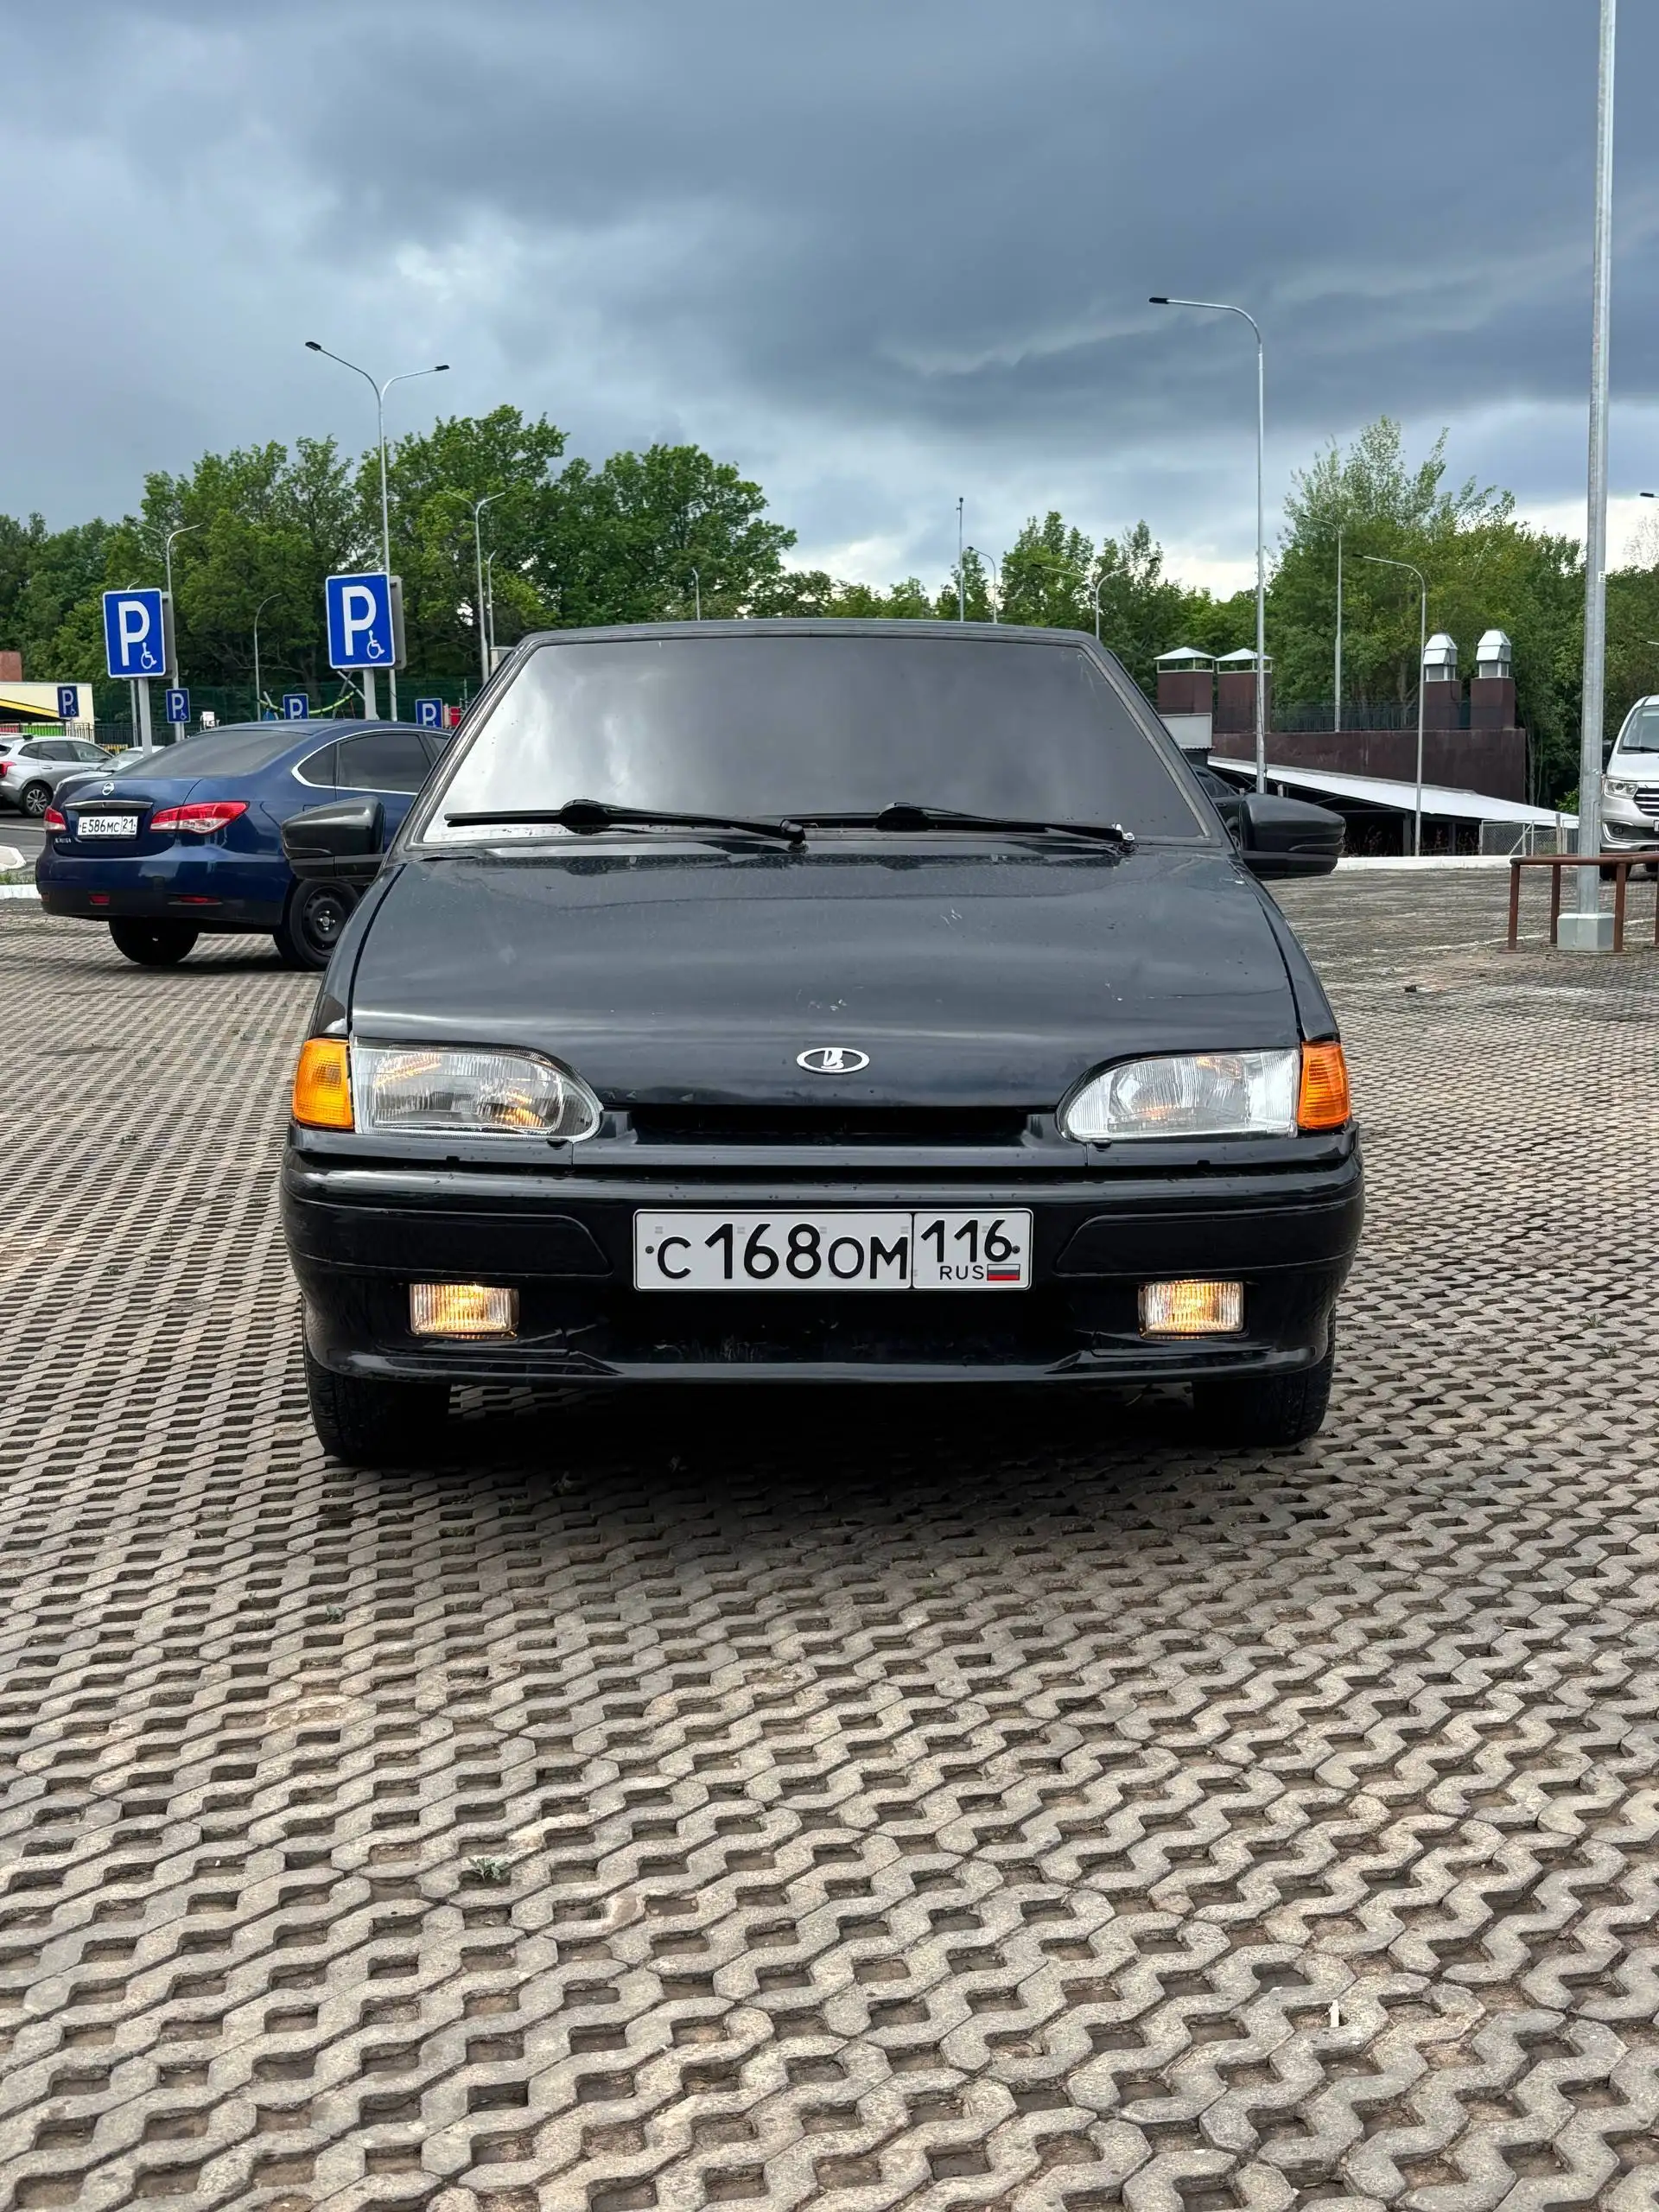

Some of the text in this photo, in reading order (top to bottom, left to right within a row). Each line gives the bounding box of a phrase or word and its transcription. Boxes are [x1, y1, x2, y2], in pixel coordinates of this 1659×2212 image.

[342, 585, 377, 656] P
[118, 601, 150, 666] P
[61, 690, 74, 715] P
[171, 693, 185, 719] P
[289, 698, 303, 719] P
[422, 703, 436, 726] P
[123, 818, 134, 830] 21
[657, 1219, 1012, 1280] С168ОМ 116
[939, 1265, 984, 1281] RUS
